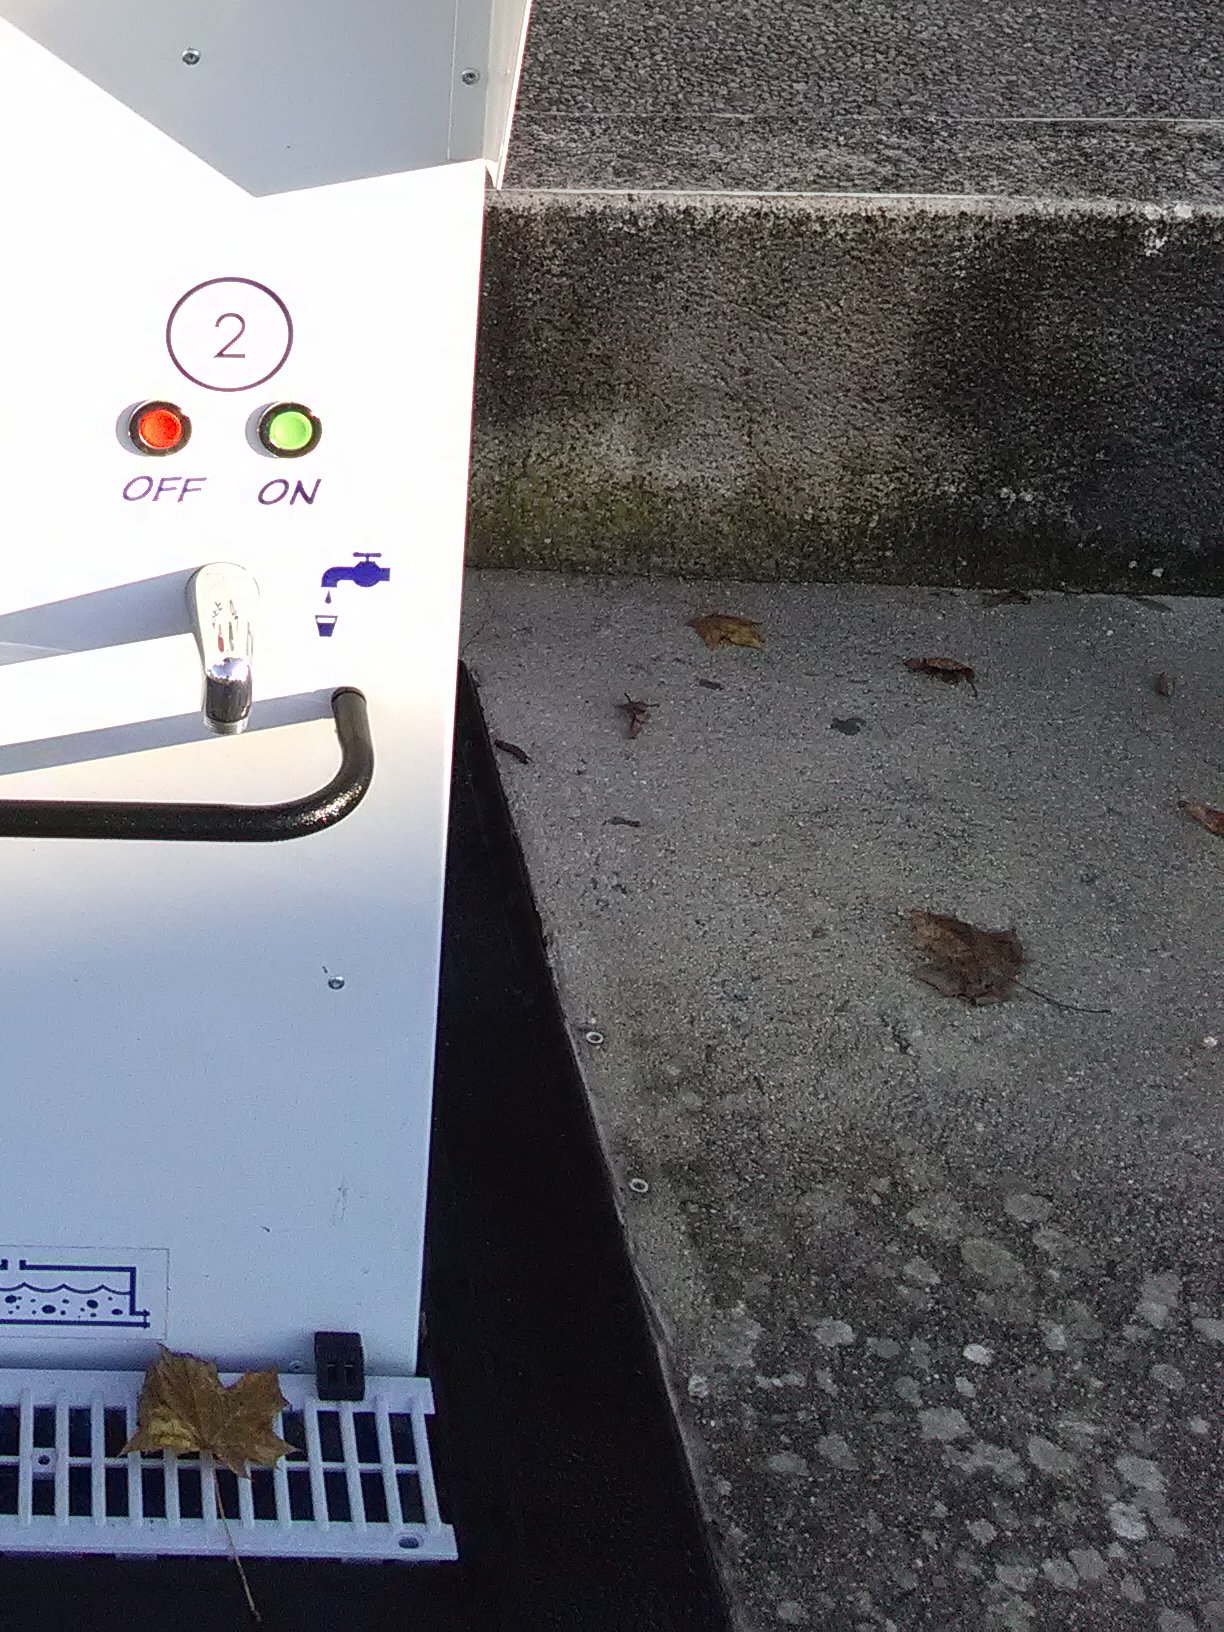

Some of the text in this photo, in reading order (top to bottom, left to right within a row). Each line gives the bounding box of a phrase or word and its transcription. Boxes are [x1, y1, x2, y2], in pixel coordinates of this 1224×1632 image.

[212, 311, 247, 359] 2
[121, 475, 323, 507] OFF ON
